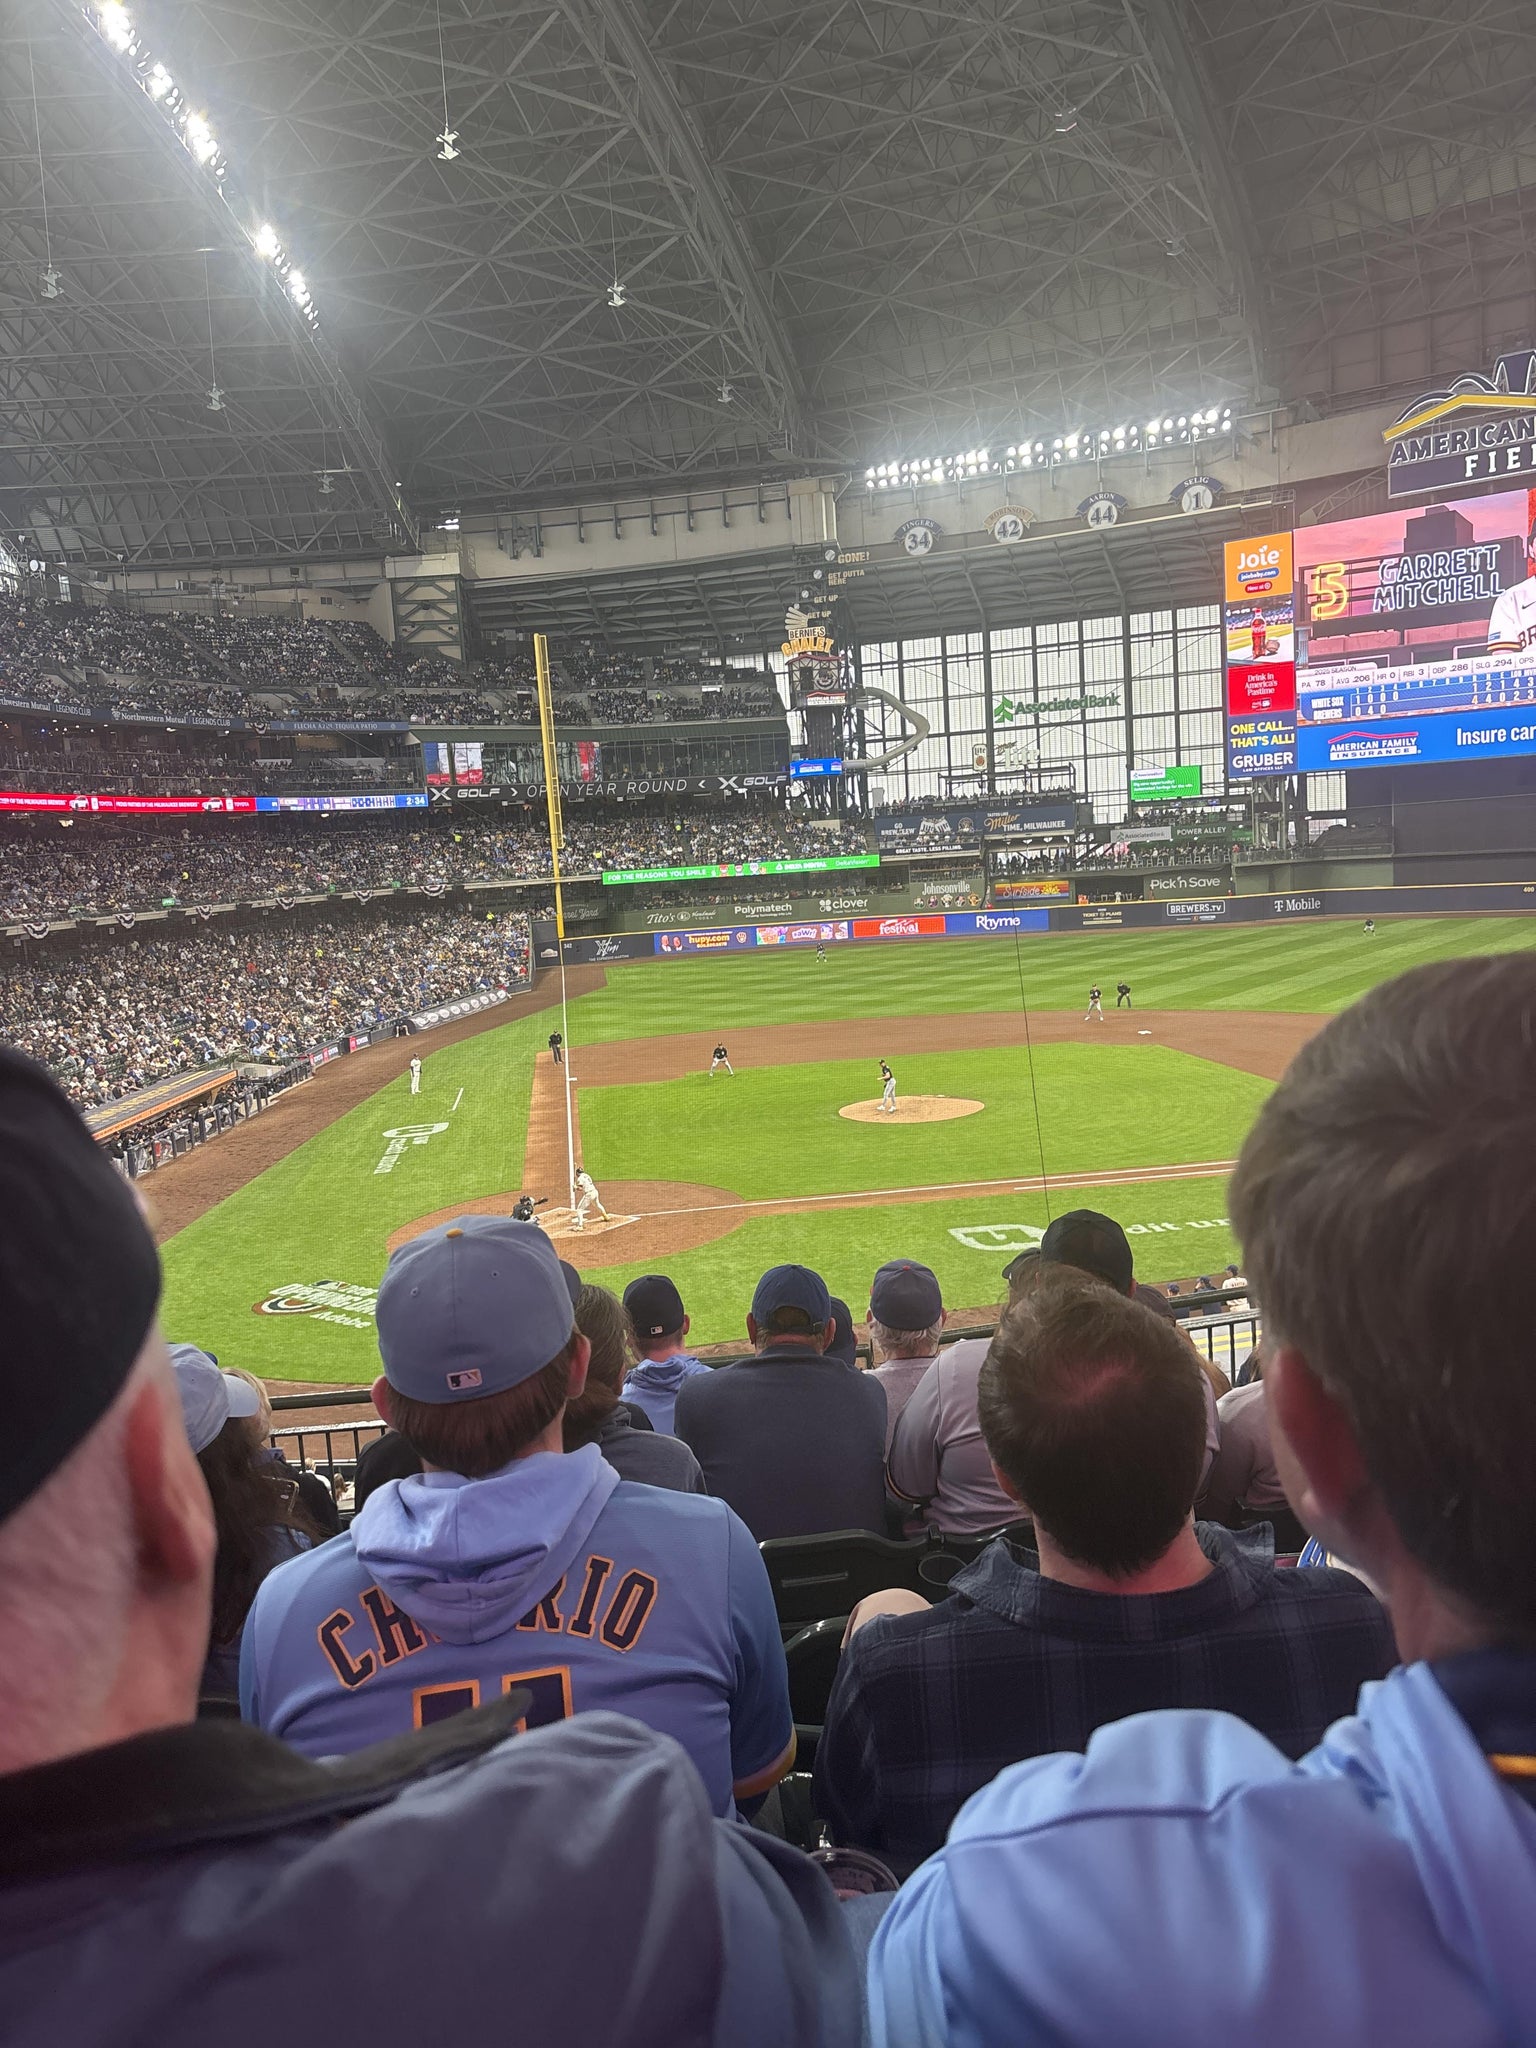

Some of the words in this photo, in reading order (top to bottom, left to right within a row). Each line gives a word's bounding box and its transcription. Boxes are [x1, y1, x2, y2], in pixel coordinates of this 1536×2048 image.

[1390, 416, 1536, 466] AMERICAN
[1465, 443, 1536, 478] FIE
[1183, 476, 1209, 487] SELIG
[1088, 493, 1116, 504] AARON
[1192, 492, 1204, 510] 1
[988, 507, 1027, 524] ROBINSON
[1090, 506, 1115, 524] 44
[901, 520, 935, 533] FINGERS
[997, 522, 1021, 538] 42
[907, 532, 931, 550] 34
[837, 551, 870, 564] GONE!
[1237, 545, 1280, 570] Joie
[1378, 544, 1501, 584] GARRETT
[827, 572, 841, 580] GET
[843, 569, 865, 578] OUTTA
[828, 577, 847, 586] HERE
[1240, 569, 1277, 581] joiebaby.com
[1313, 562, 1348, 619] 5
[1372, 572, 1506, 613] MITCHELL
[814, 596, 828, 604] GET
[828, 594, 839, 602] UP
[821, 610, 832, 618] UP
[788, 626, 826, 640] BERNIE'S
[781, 636, 835, 657] CHALET
[1247, 674, 1266, 682] Drink
[1336, 677, 1350, 685] AVG
[1352, 675, 1370, 683] .206
[1449, 664, 1469, 673] .286
[1493, 658, 1513, 667] .294
[1245, 680, 1278, 689] America's
[1247, 687, 1275, 696] Pastime
[1311, 697, 1331, 709] WHITE
[1331, 696, 1344, 706] SOX
[1355, 695, 1360, 704] 1
[1368, 694, 1373, 703] 0
[1380, 693, 1386, 702] 0
[1393, 691, 1399, 701] 0
[1473, 683, 1477, 692] 1
[1486, 682, 1491, 691] 2
[1500, 680, 1505, 689] 1
[1513, 678, 1520, 688] 4
[1528, 677, 1534, 686] 3
[30, 700, 51, 711] Mutual
[55, 704, 78, 715] LEGENDS
[78, 707, 91, 716] CLUB
[1355, 707, 1361, 716] 0
[1368, 706, 1374, 715] 4
[1380, 704, 1386, 714] 0
[1471, 695, 1478, 704] 4
[1486, 693, 1492, 703] 4
[1499, 692, 1506, 702] 0
[1514, 691, 1520, 700] 2
[1528, 690, 1534, 699] 3
[121, 713, 164, 723] Northwestern
[165, 715, 187, 724] Mutual
[192, 717, 215, 726] LEGENDS
[216, 718, 231, 727] CLUB
[1230, 723, 1256, 735] ONE
[1456, 726, 1507, 746] Insure
[1230, 735, 1269, 748] THAT'S
[1270, 733, 1295, 745] ALL!
[1330, 740, 1380, 752] AMERICAN
[1382, 737, 1417, 748] FAMILY
[1232, 751, 1294, 769] GRUBER
[1336, 748, 1411, 759] INSURANCE
[457, 788, 500, 798] GOLF
[577, 782, 617, 796] YEAR
[627, 779, 688, 794] ROUND
[743, 775, 788, 786] GOLF
[406, 797, 425, 805] 2:34
[984, 813, 1021, 830] Miller
[1003, 823, 1023, 832] TIME,
[1023, 820, 1066, 830] MILWAUKEE
[1176, 828, 1202, 836] POWER
[1203, 826, 1227, 834] ALLEY
[608, 873, 621, 882] FOR
[622, 872, 634, 881] THE
[635, 870, 668, 880] REASONS
[670, 869, 685, 878] YOU
[686, 868, 706, 877] SMILE
[922, 881, 971, 896] Johnsonville
[1150, 879, 1176, 890] Pick
[1189, 876, 1221, 888] Save
[1002, 884, 1041, 898] Surfside
[734, 903, 792, 915] Polymatech
[832, 898, 868, 909] clover
[1170, 903, 1222, 914] BREWERS.TV
[1286, 898, 1321, 912] Mobile
[647, 912, 676, 924] Tito's
[975, 915, 1021, 930] Rhyme
[879, 921, 919, 935] festival
[688, 934, 730, 945] hupy.com
[317, 1554, 659, 1690] CHRIO
